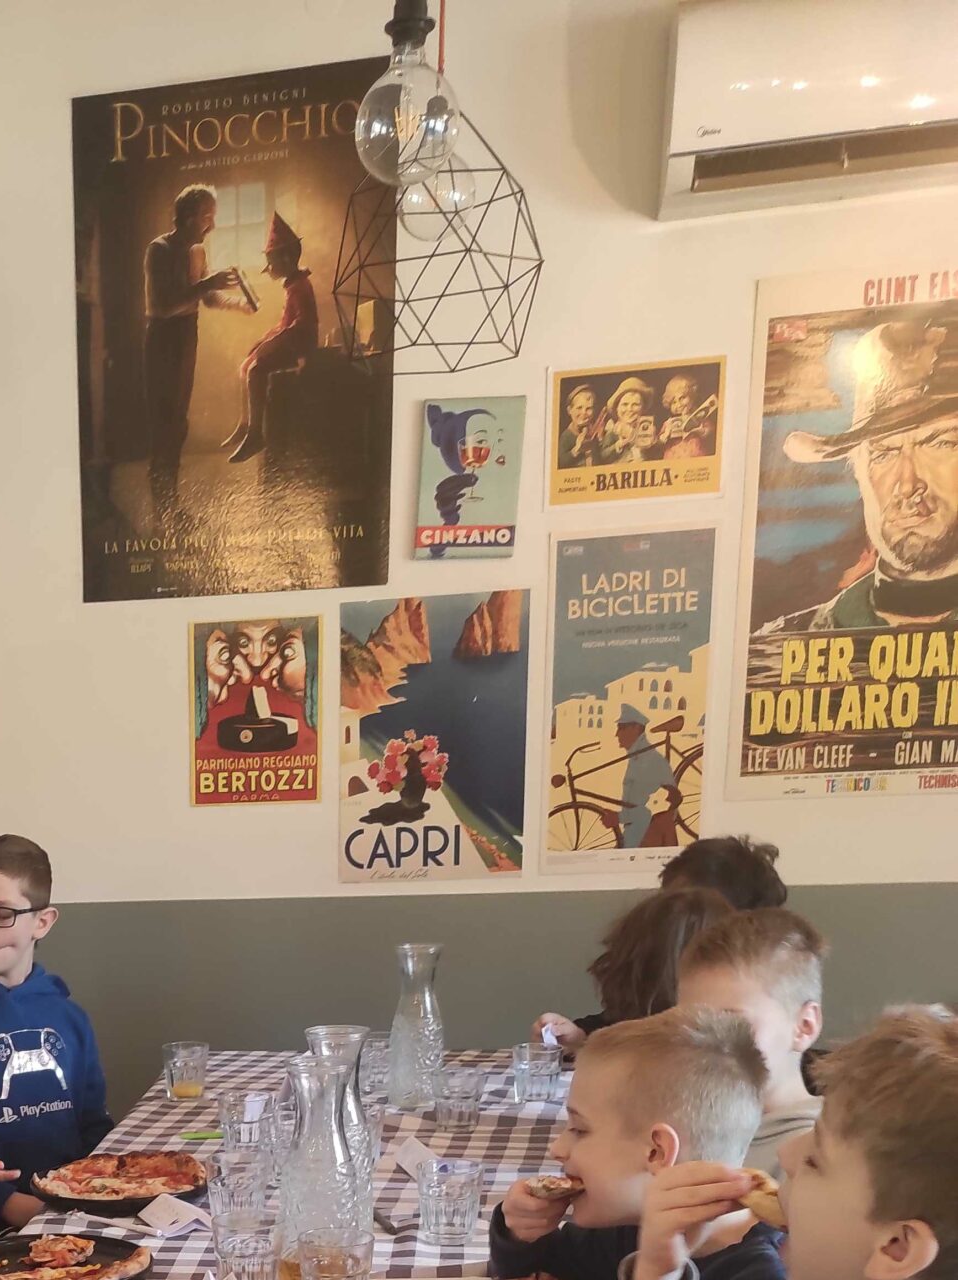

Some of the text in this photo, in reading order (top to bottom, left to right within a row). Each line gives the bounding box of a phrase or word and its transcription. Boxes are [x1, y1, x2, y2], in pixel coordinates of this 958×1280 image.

[161, 87, 308, 116] ROBERTO BENIGNI
[110, 101, 360, 163] PINOCCHIO
[863, 275, 919, 306] CLINT
[595, 468, 673, 492] BARILLA
[104, 540, 119, 555] LA
[125, 536, 177, 553] FAVOLA
[333, 524, 364, 540] VITA
[420, 528, 512, 545] CINZANO
[581, 567, 686, 595] LADRI DI
[567, 590, 699, 620] BICICLETTE
[780, 637, 855, 685] PER
[749, 682, 921, 736] DOLLARO
[196, 754, 317, 770] PARMIGIANO REGGIANO
[747, 748, 770, 773] LEE
[776, 746, 806, 771] VAN
[812, 744, 854, 769] CLEEF
[894, 740, 933, 766] GIAN
[199, 768, 313, 793] BERTOZZI
[344, 824, 460, 869] CAPRI
[19, 1100, 72, 1118] PlayStation
